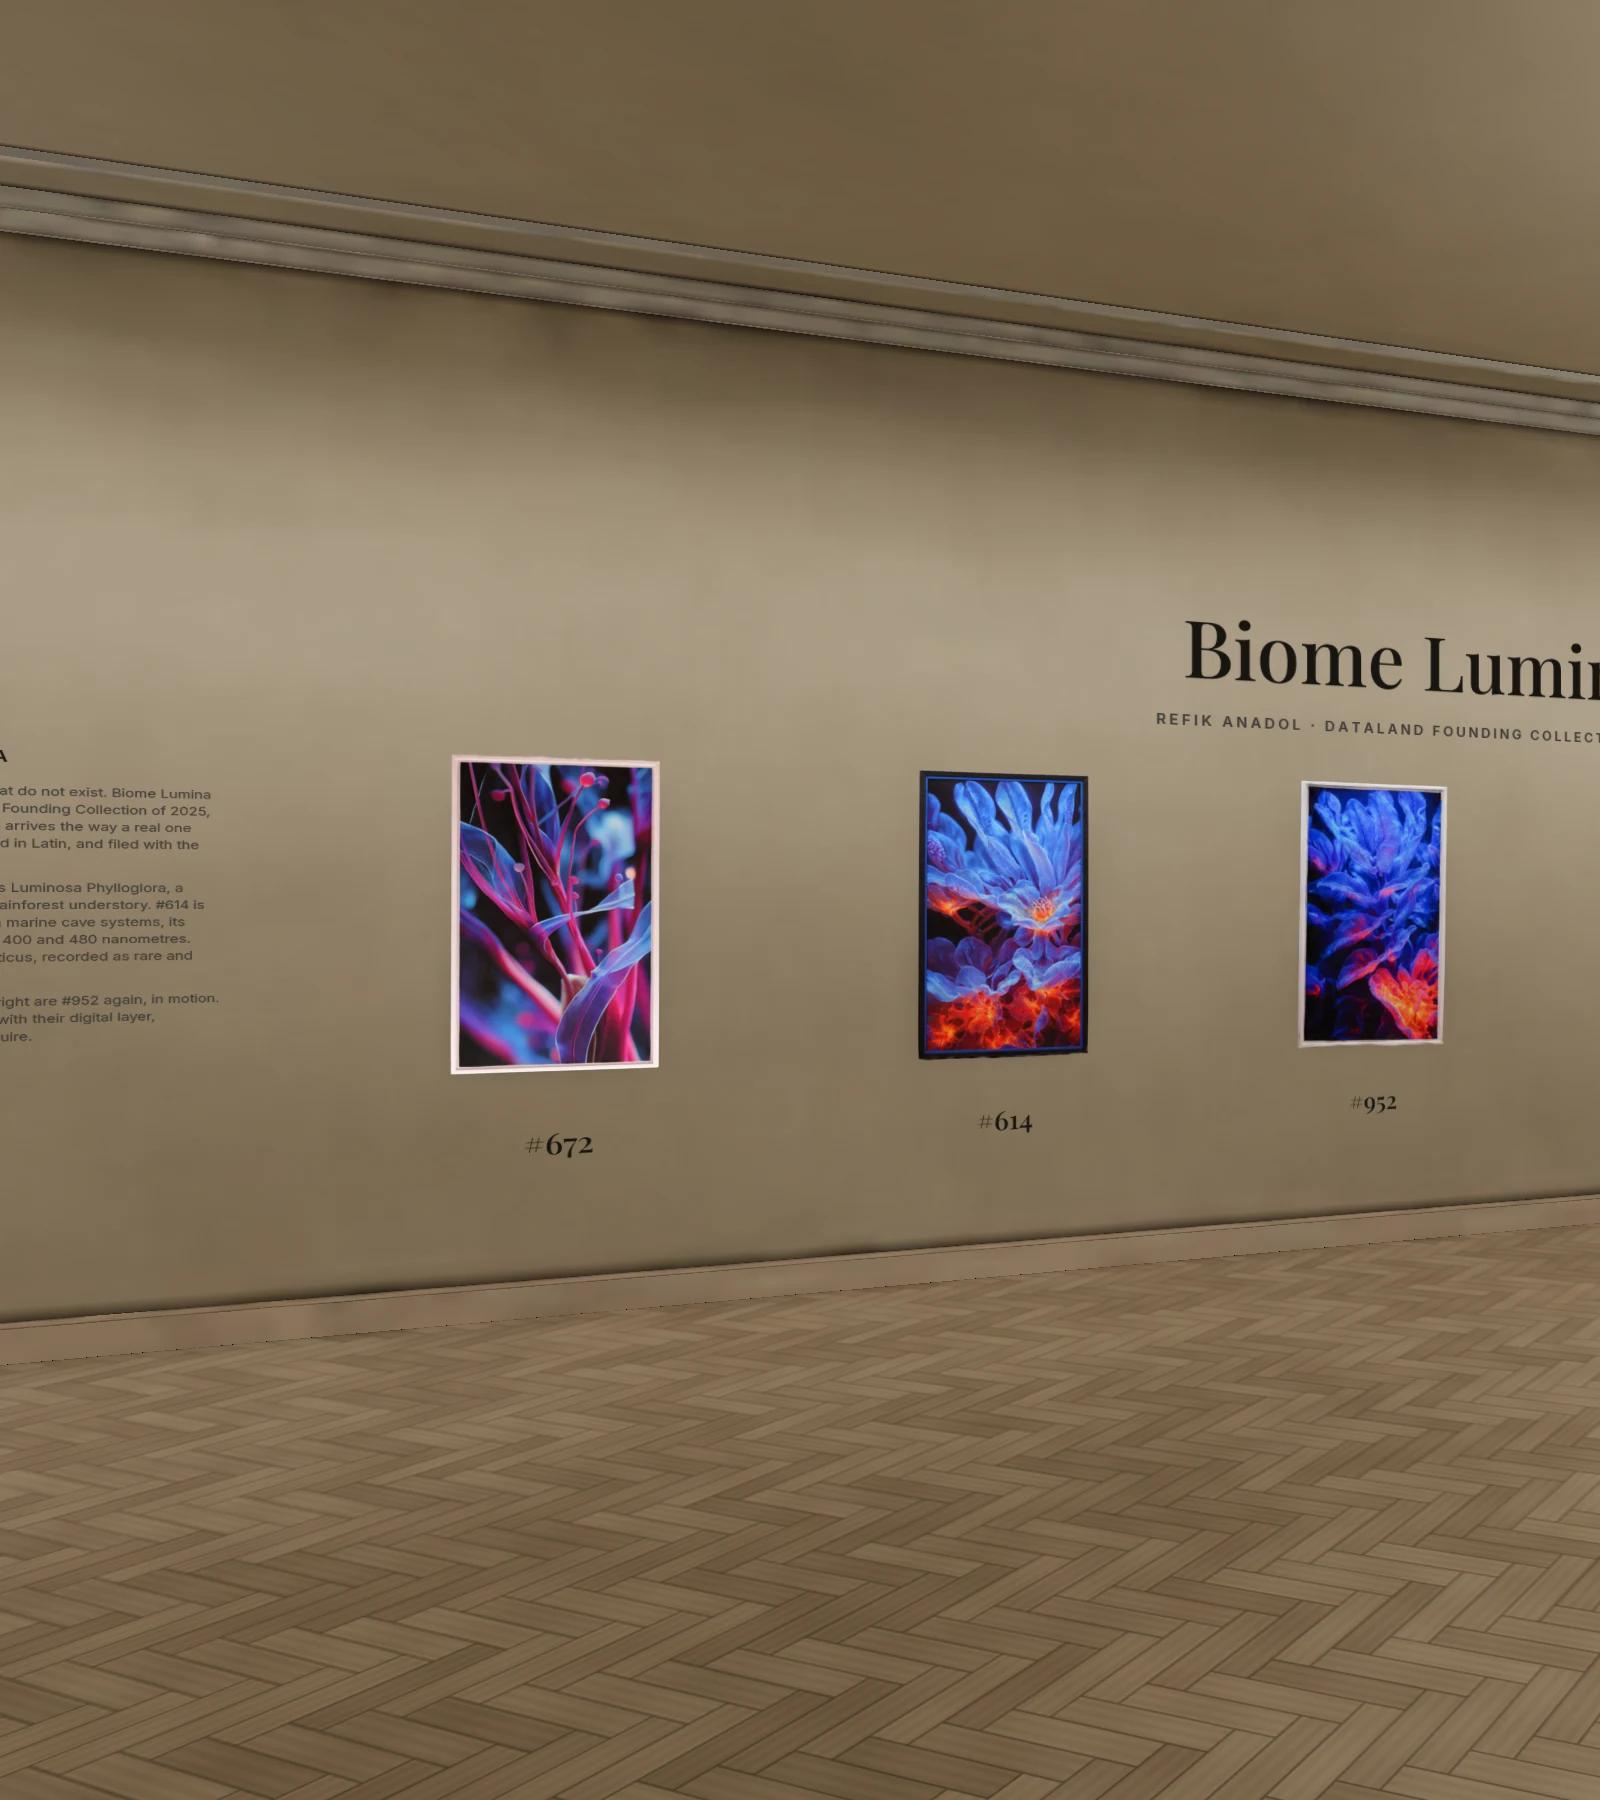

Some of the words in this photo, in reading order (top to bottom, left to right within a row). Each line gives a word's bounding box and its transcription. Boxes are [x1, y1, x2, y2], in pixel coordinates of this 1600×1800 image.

[1185, 620, 1402, 691] Biome
[1156, 713, 1213, 727] REFIK
[1222, 716, 1302, 731] ANADOL
[1324, 720, 1424, 736] DATALAND
[1432, 725, 1523, 741] FOUNDING
[18, 785, 37, 797] do
[41, 786, 66, 797] not
[69, 786, 108, 799] exist.
[112, 787, 157, 799] Biome
[161, 788, 212, 800] Lumina
[2, 802, 71, 817] Founding
[76, 804, 147, 816] Collection
[152, 805, 167, 816] of
[171, 806, 211, 819] 2025,
[5, 820, 57, 832] arrives
[60, 821, 84, 832] the
[88, 823, 118, 835] way
[121, 824, 131, 833] a
[135, 822, 161, 833] real
[165, 824, 193, 833] one
[14, 837, 27, 849] in
[32, 837, 72, 851] Latin,
[76, 839, 104, 849] and
[108, 838, 140, 850] filed
[143, 839, 173, 850] with
[177, 840, 200, 851] the
[12, 881, 83, 893] Luminosa
[175, 884, 184, 893] a
[69, 899, 152, 913] understory.
[156, 899, 190, 910] #614
[193, 899, 205, 910] is
[7, 916, 57, 928] marine
[61, 919, 97, 928] cave
[101, 917, 165, 930] systems,
[169, 916, 186, 927] its
[3, 934, 33, 945] 400
[37, 934, 65, 945] and
[69, 934, 98, 945] 480
[102, 934, 191, 945] nanometres.
[42, 951, 109, 963] recorded
[113, 952, 131, 962] as
[134, 952, 163, 961] rare
[166, 950, 193, 961] and
[0, 996, 31, 1010] ight
[34, 997, 58, 1007] are
[62, 994, 99, 1006] #952
[104, 994, 147, 1008] again,
[152, 993, 164, 1005] in
[168, 993, 220, 1005] motion.
[0, 1013, 28, 1025] with
[32, 1013, 66, 1024] their
[69, 1012, 113, 1025] digital
[118, 1011, 155, 1024] layer,
[1350, 1094, 1397, 1114] #952
[978, 1110, 1033, 1134] #614
[525, 1132, 594, 1159] #672
